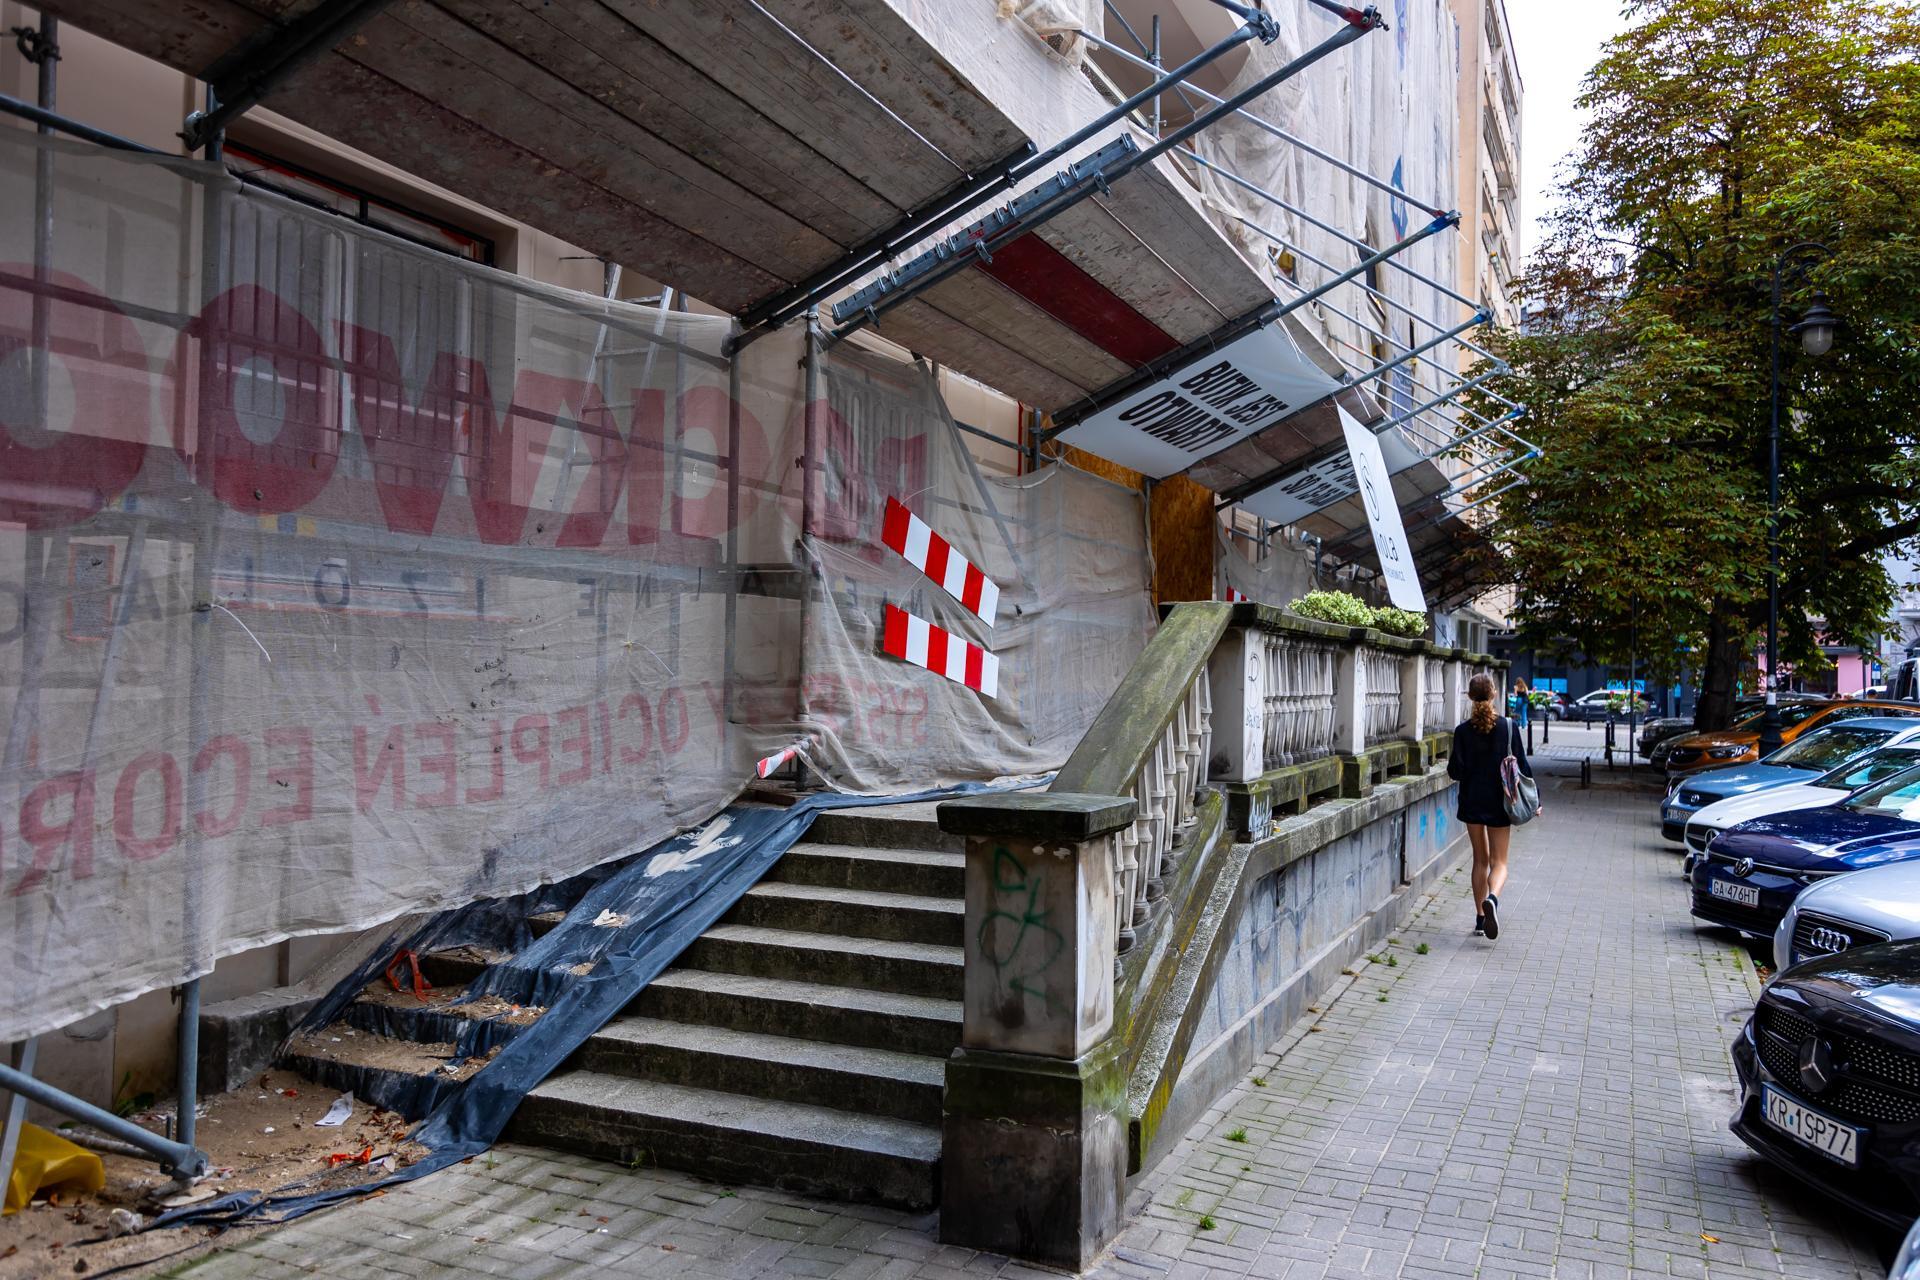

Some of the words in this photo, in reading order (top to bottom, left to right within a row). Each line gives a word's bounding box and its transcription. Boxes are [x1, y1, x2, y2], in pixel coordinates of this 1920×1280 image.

[1118, 390, 1239, 453] OTWARTY
[1179, 360, 1262, 410] BUTIK
[1223, 393, 1290, 426] JEST
[1713, 880, 1725, 896] GA
[1727, 884, 1757, 905] 476HT
[1769, 1093, 1788, 1128] KR
[1795, 1108, 1852, 1156] 1SP77
